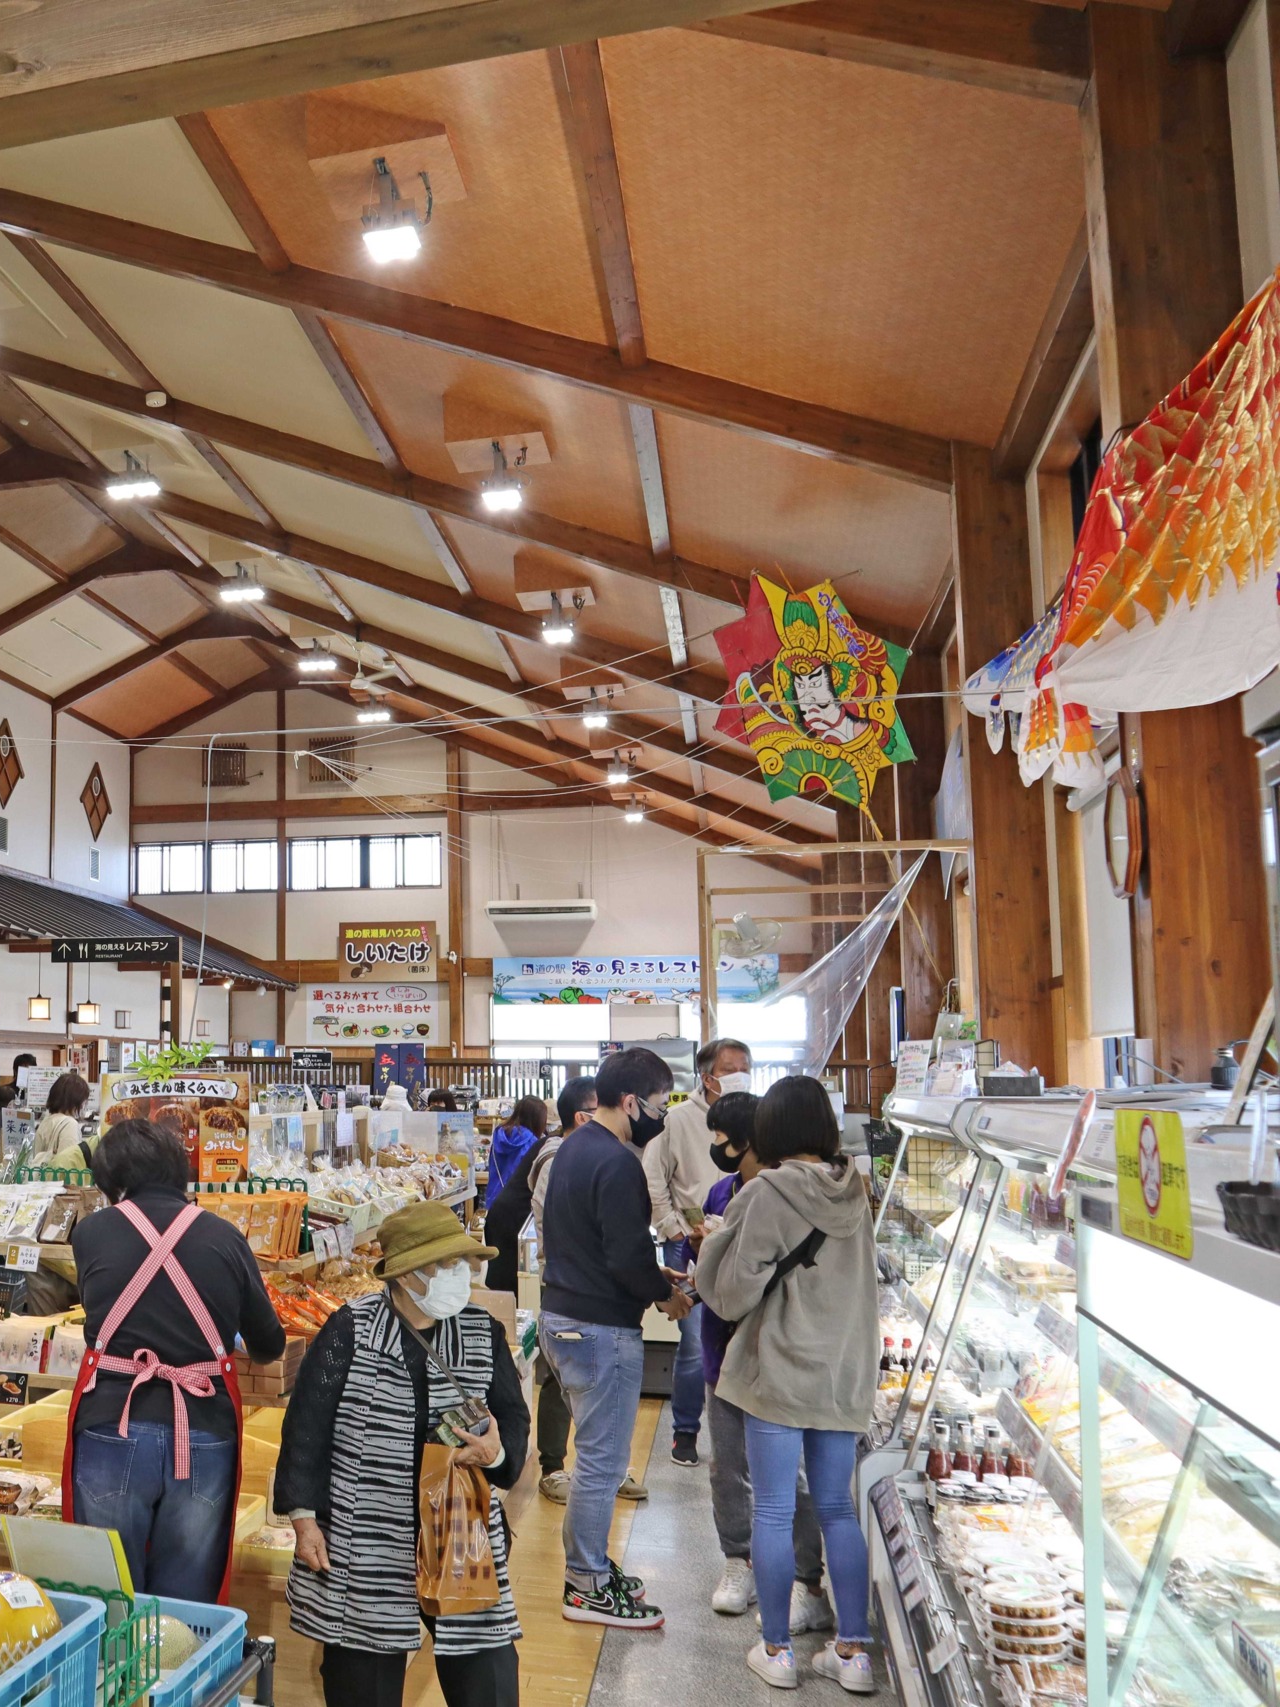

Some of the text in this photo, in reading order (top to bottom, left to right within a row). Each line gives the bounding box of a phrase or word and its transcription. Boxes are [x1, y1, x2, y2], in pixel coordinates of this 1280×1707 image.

[345, 928, 420, 939] 道の駅潮見ハウスの
[94, 941, 169, 952] 海の見えるレストラン
[346, 941, 431, 964] しいたけ
[535, 959, 734, 976] 道の駅 海の見えるレストン
[313, 989, 379, 1001] 選べるおかずで
[130, 1080, 219, 1096] みそまん味くらべ
[11, 1249, 16, 1257] 2
